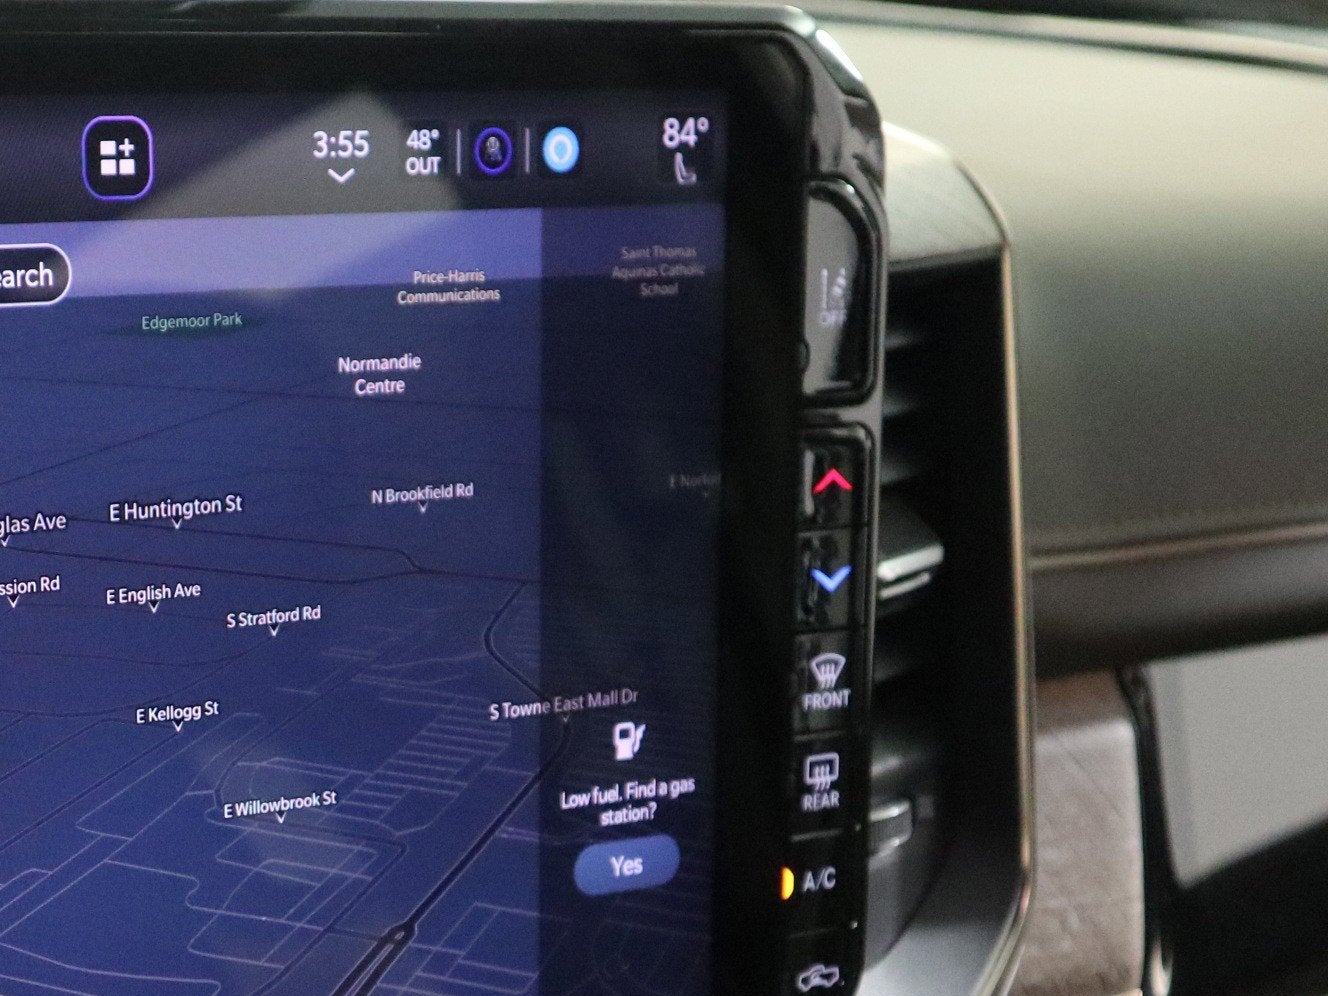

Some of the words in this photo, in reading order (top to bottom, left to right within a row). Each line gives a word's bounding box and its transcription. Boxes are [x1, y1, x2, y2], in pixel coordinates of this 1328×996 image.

[313, 130, 370, 159] 3:55
[406, 155, 441, 176] OUT
[621, 246, 650, 260] Saint
[653, 244, 697, 260] Thomas
[414, 269, 486, 285] Price-Harris
[397, 287, 501, 305] Communications
[640, 282, 679, 297] School
[141, 313, 211, 332] Edgemoor
[213, 312, 243, 327] Park
[338, 353, 422, 374] Normandie
[355, 377, 405, 396] Centre
[372, 489, 383, 504] N
[386, 485, 454, 502] Brookfield
[456, 482, 474, 498] Rd
[110, 504, 120, 521] E
[124, 498, 222, 522] Huntington
[225, 494, 243, 512] St
[33, 512, 67, 530] Ave
[41, 576, 60, 592] Rd
[107, 590, 115, 604] E
[119, 586, 172, 605] English
[174, 583, 201, 598] Ave
[227, 613, 236, 628] S
[239, 608, 300, 627] Stratford
[303, 605, 322, 620] Rd
[489, 703, 500, 721] S
[502, 700, 551, 718] Towne
[553, 694, 585, 711] East
[587, 691, 619, 708] Mall
[621, 689, 639, 704] Dr
[802, 688, 851, 710] FRONT
[137, 709, 145, 723] E
[149, 704, 201, 724] Kellogg
[204, 701, 219, 715] St
[224, 804, 233, 819] E
[235, 793, 320, 817] Willowbrook
[322, 790, 337, 805] St
[560, 791, 590, 810] Low
[591, 783, 624, 803] fuel.
[625, 779, 657, 799] Find
[659, 780, 668, 795] a
[669, 777, 696, 798] gas
[802, 791, 840, 811] REAR
[600, 801, 658, 827] station?
[610, 855, 644, 878] Yes
[803, 866, 836, 891] A/C
